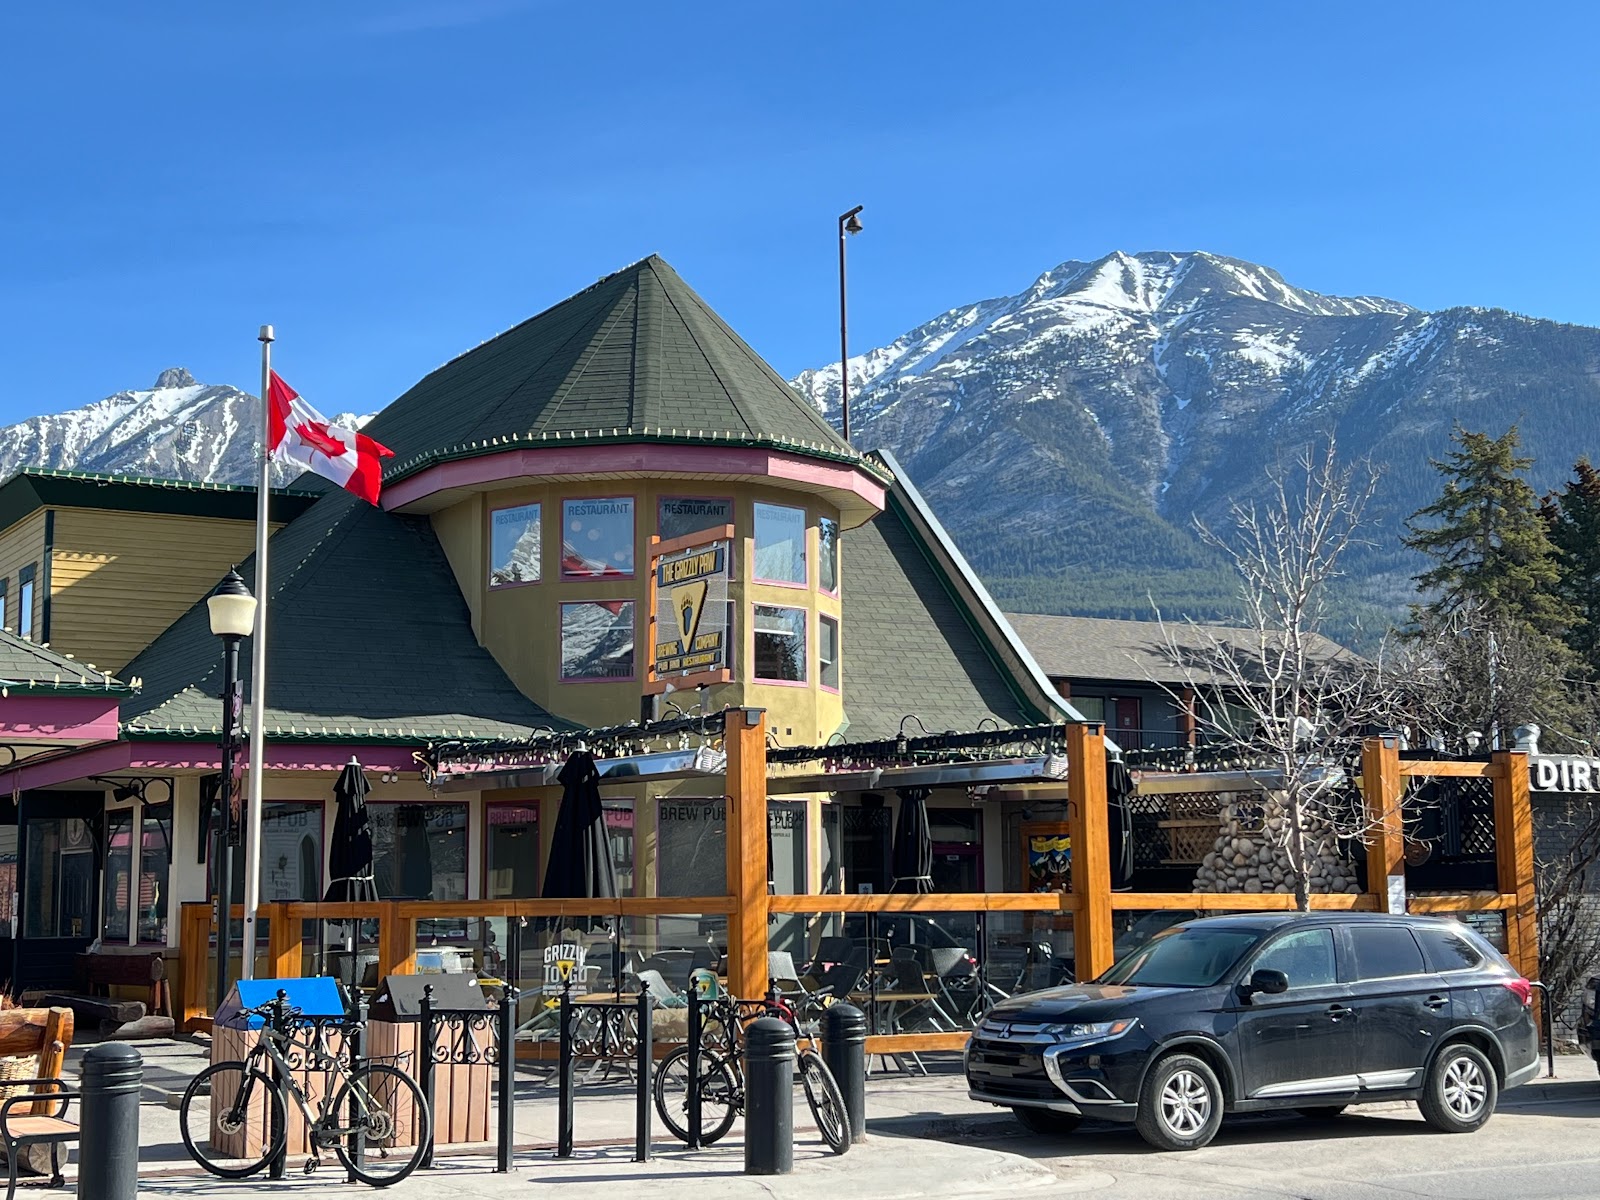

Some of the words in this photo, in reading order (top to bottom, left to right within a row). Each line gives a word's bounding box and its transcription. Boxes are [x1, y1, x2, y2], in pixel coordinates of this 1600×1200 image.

[495, 509, 538, 525] RESTAURANT
[568, 504, 629, 516] RESTAURANT
[664, 503, 726, 516] RESTAURANT
[757, 508, 801, 524] RESTAURANT
[662, 563, 675, 584] THE
[675, 556, 699, 581] GRIZZLY
[699, 550, 716, 575] PAW
[695, 632, 720, 651] COMPANY
[490, 810, 517, 825] BREW
[520, 809, 537, 823] PUB
[660, 806, 699, 820] BREW
[543, 943, 588, 964] GRIZZLY
[543, 965, 560, 983] TO
[569, 966, 588, 983] GO
